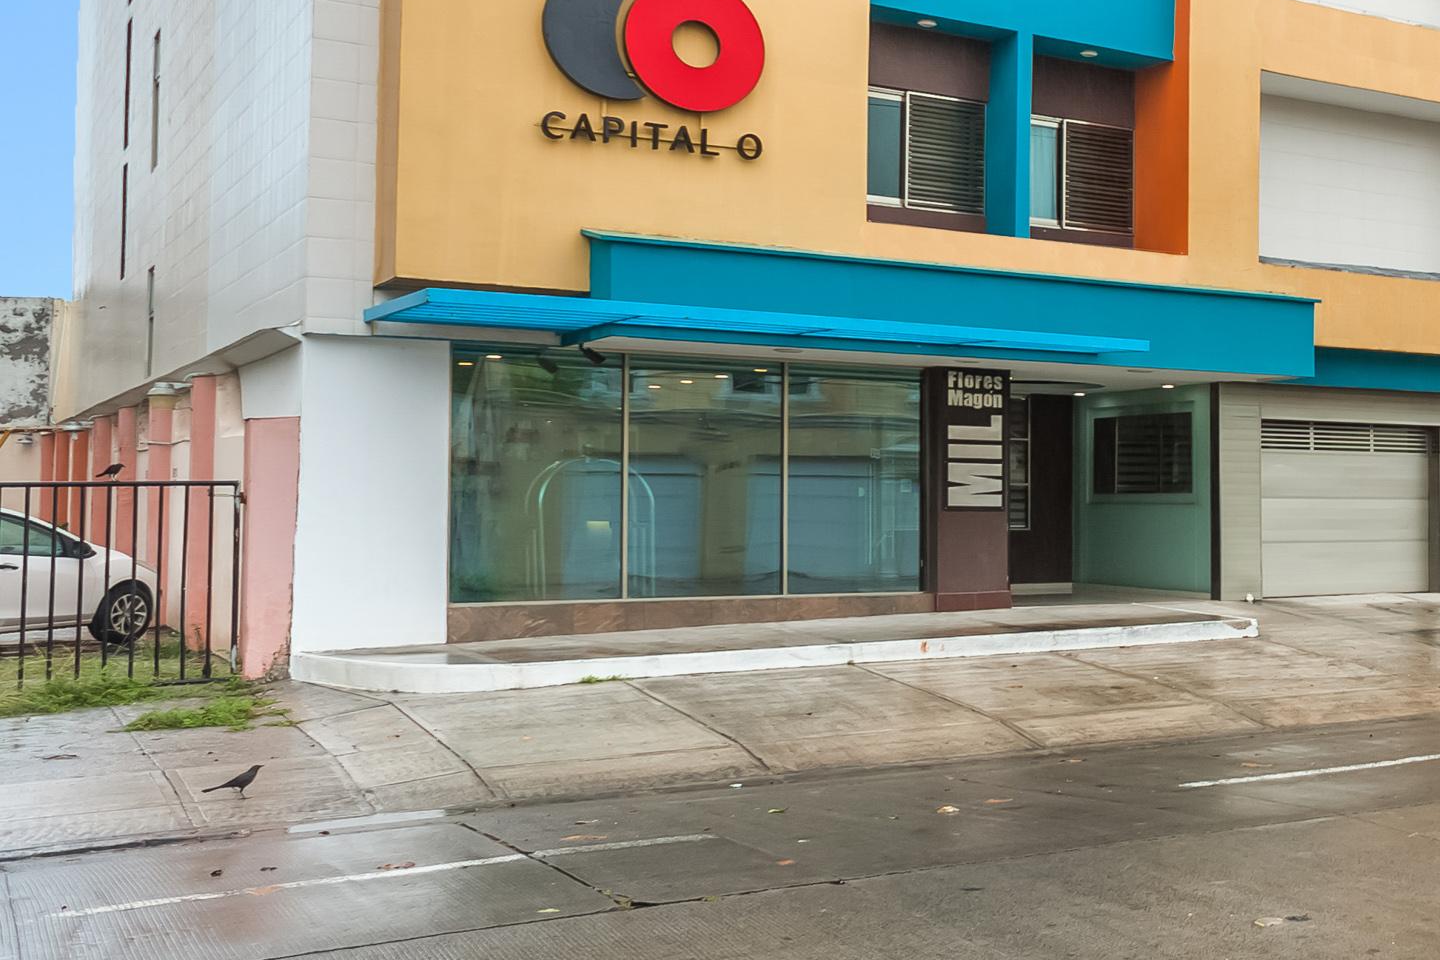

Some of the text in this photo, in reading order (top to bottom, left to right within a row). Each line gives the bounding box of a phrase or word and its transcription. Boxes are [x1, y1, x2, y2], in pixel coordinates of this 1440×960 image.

[540, 110, 763, 161] CAPITAL O
[947, 370, 1003, 390] Flores
[947, 389, 1003, 409] Magón
[947, 414, 1003, 507] MIL
